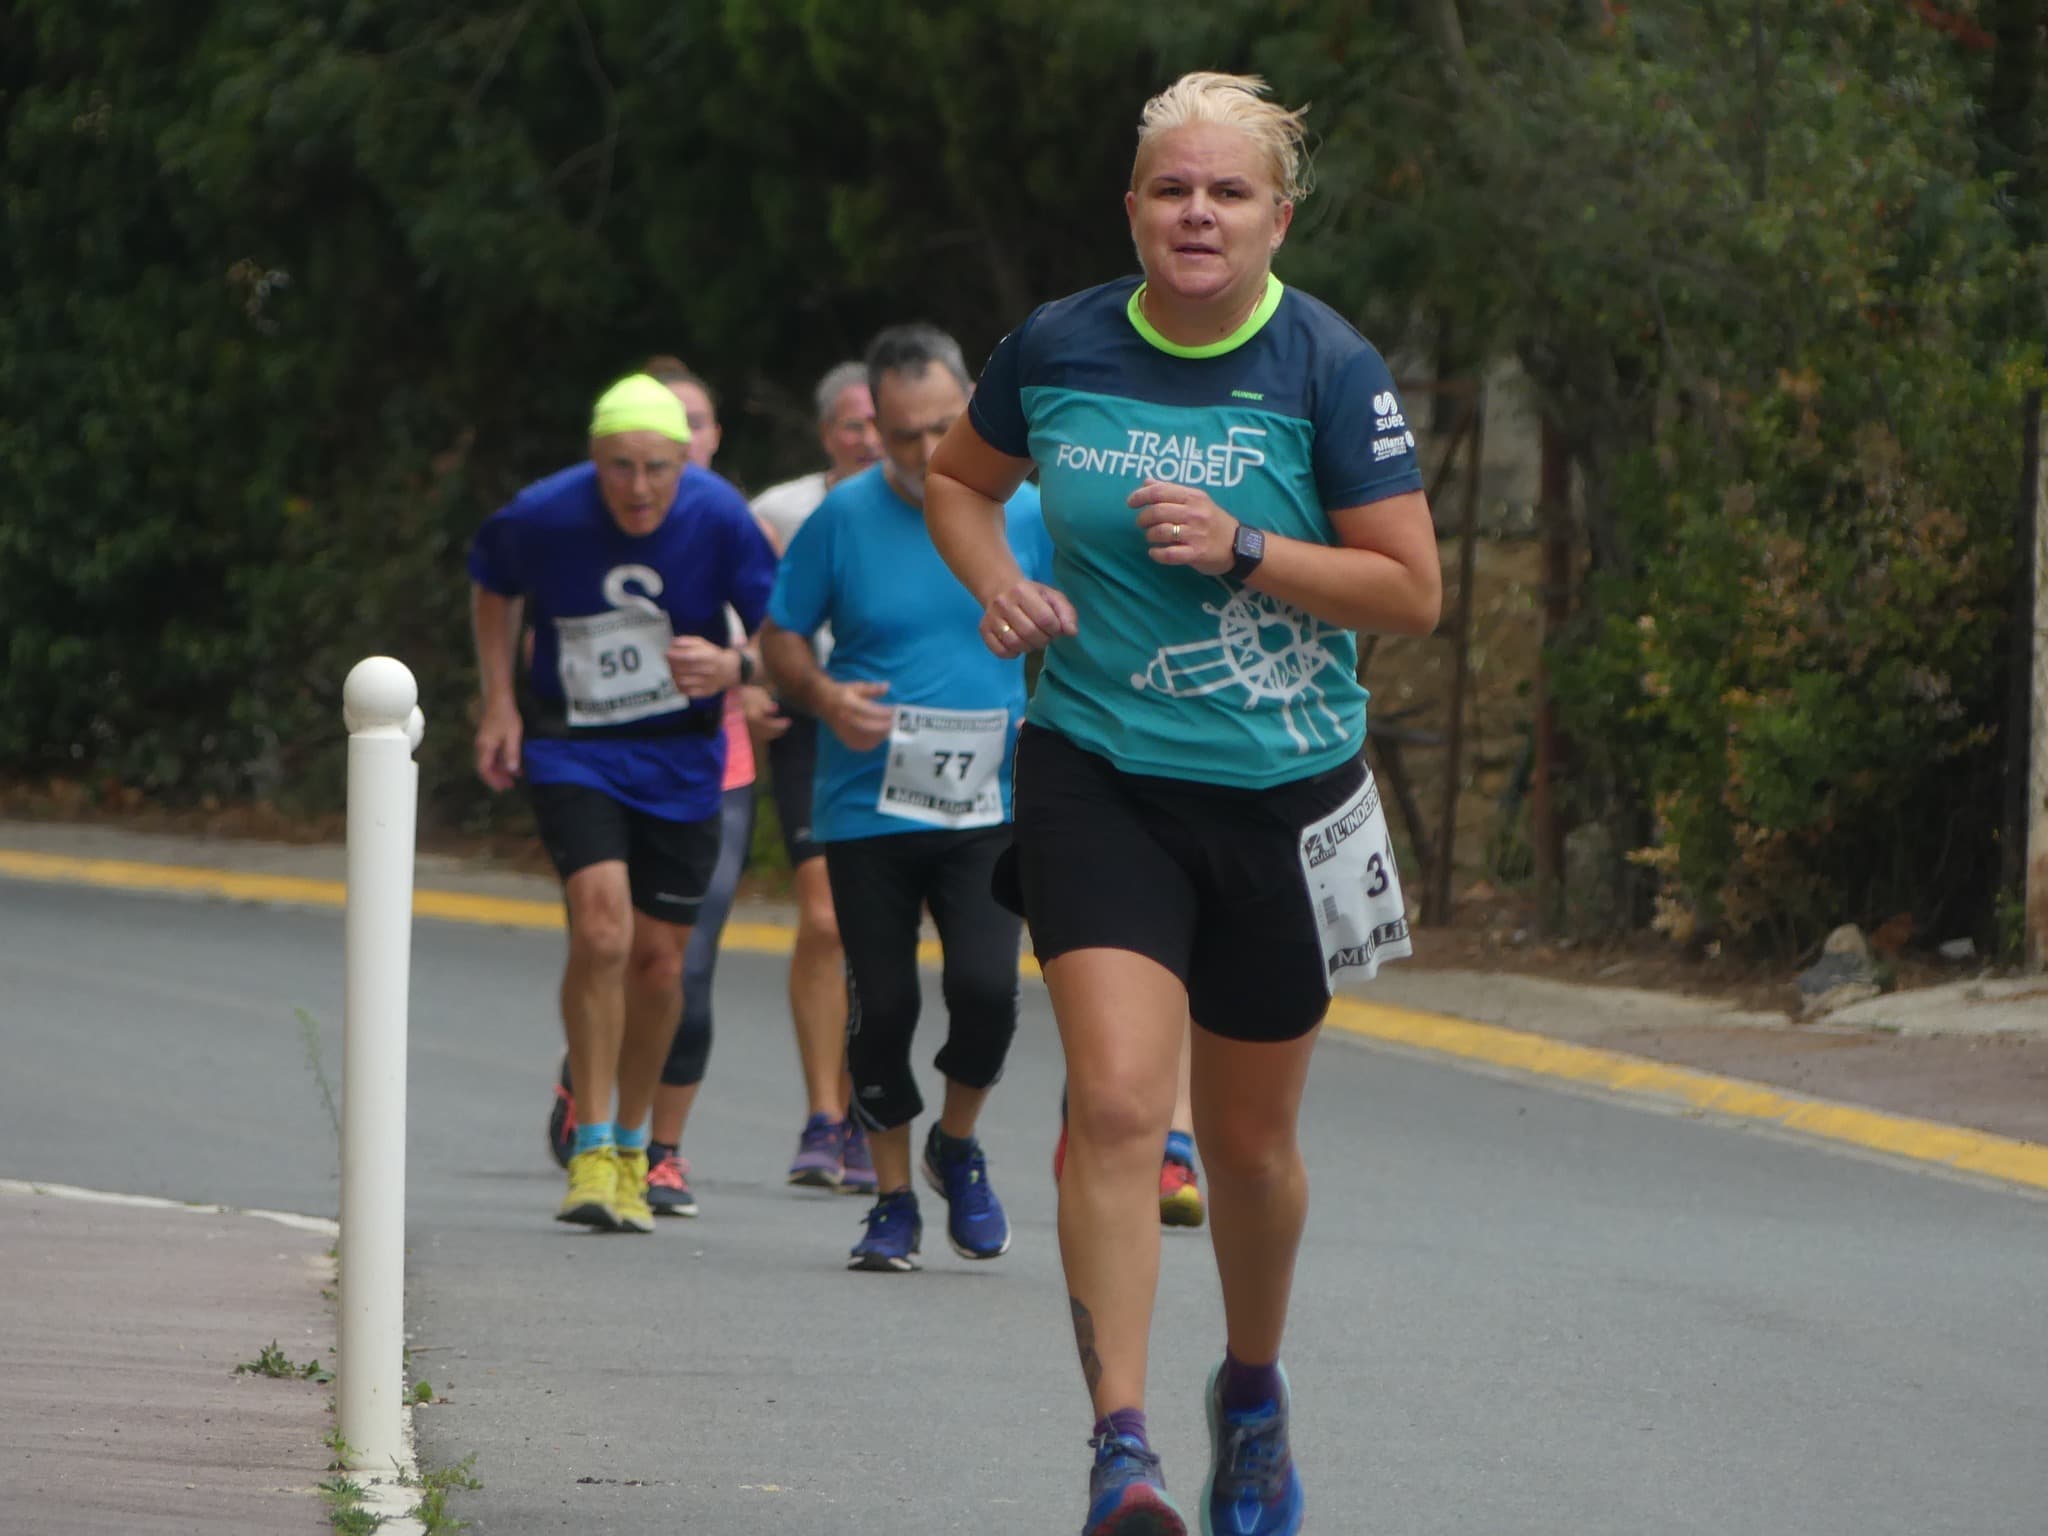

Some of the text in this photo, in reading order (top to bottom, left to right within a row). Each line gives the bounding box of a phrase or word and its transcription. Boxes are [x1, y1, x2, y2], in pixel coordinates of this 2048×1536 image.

[1127, 430, 1203, 460] TRAIL
[1056, 444, 1226, 487] FONTFROIDE
[599, 645, 641, 678] 50
[932, 750, 976, 779] 77
